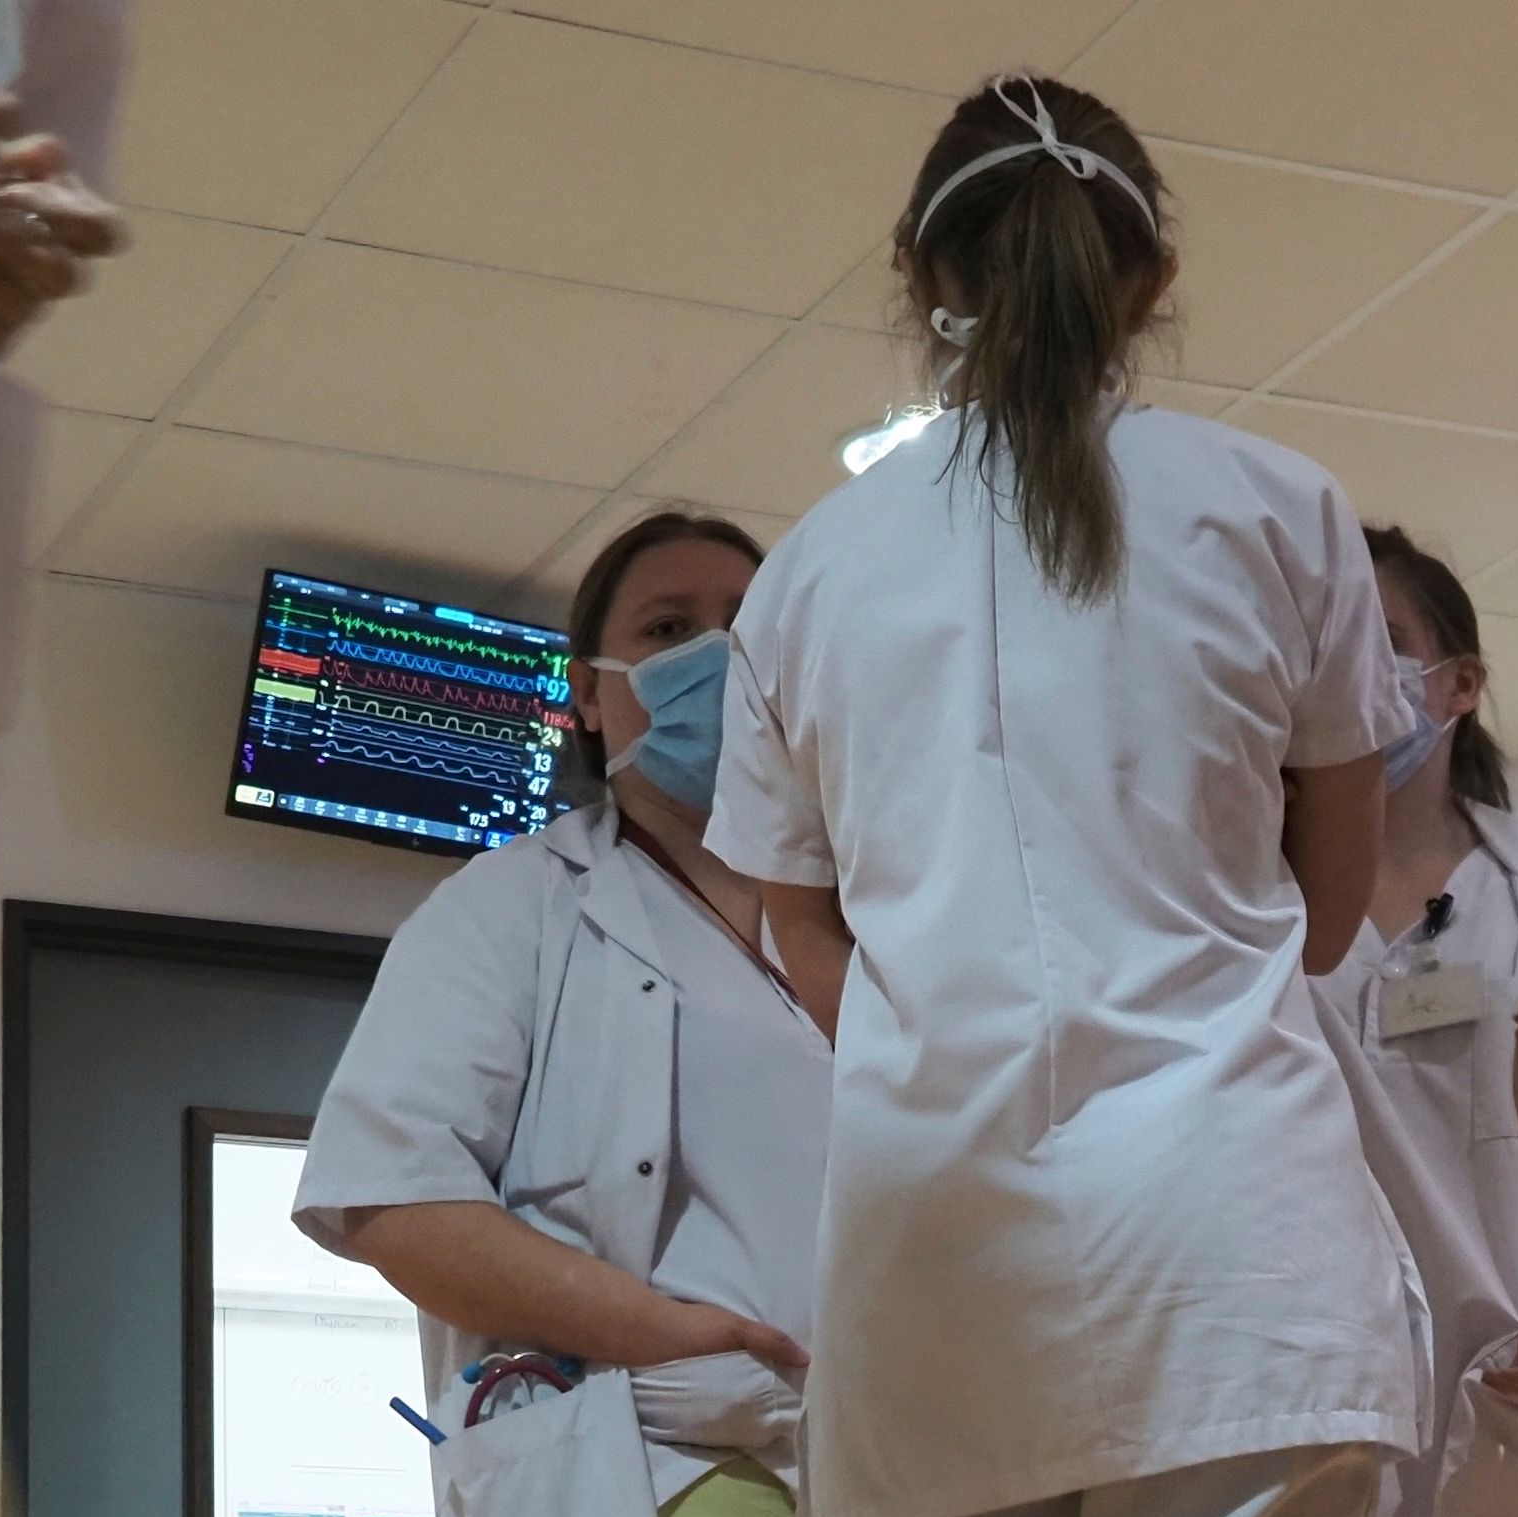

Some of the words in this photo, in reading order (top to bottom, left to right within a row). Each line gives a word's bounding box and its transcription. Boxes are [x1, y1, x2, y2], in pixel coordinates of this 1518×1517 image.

[546, 679, 570, 703] 97
[542, 726, 562, 747] 24
[534, 752, 552, 773] 13
[528, 776, 550, 796] 47
[503, 800, 516, 815] 13
